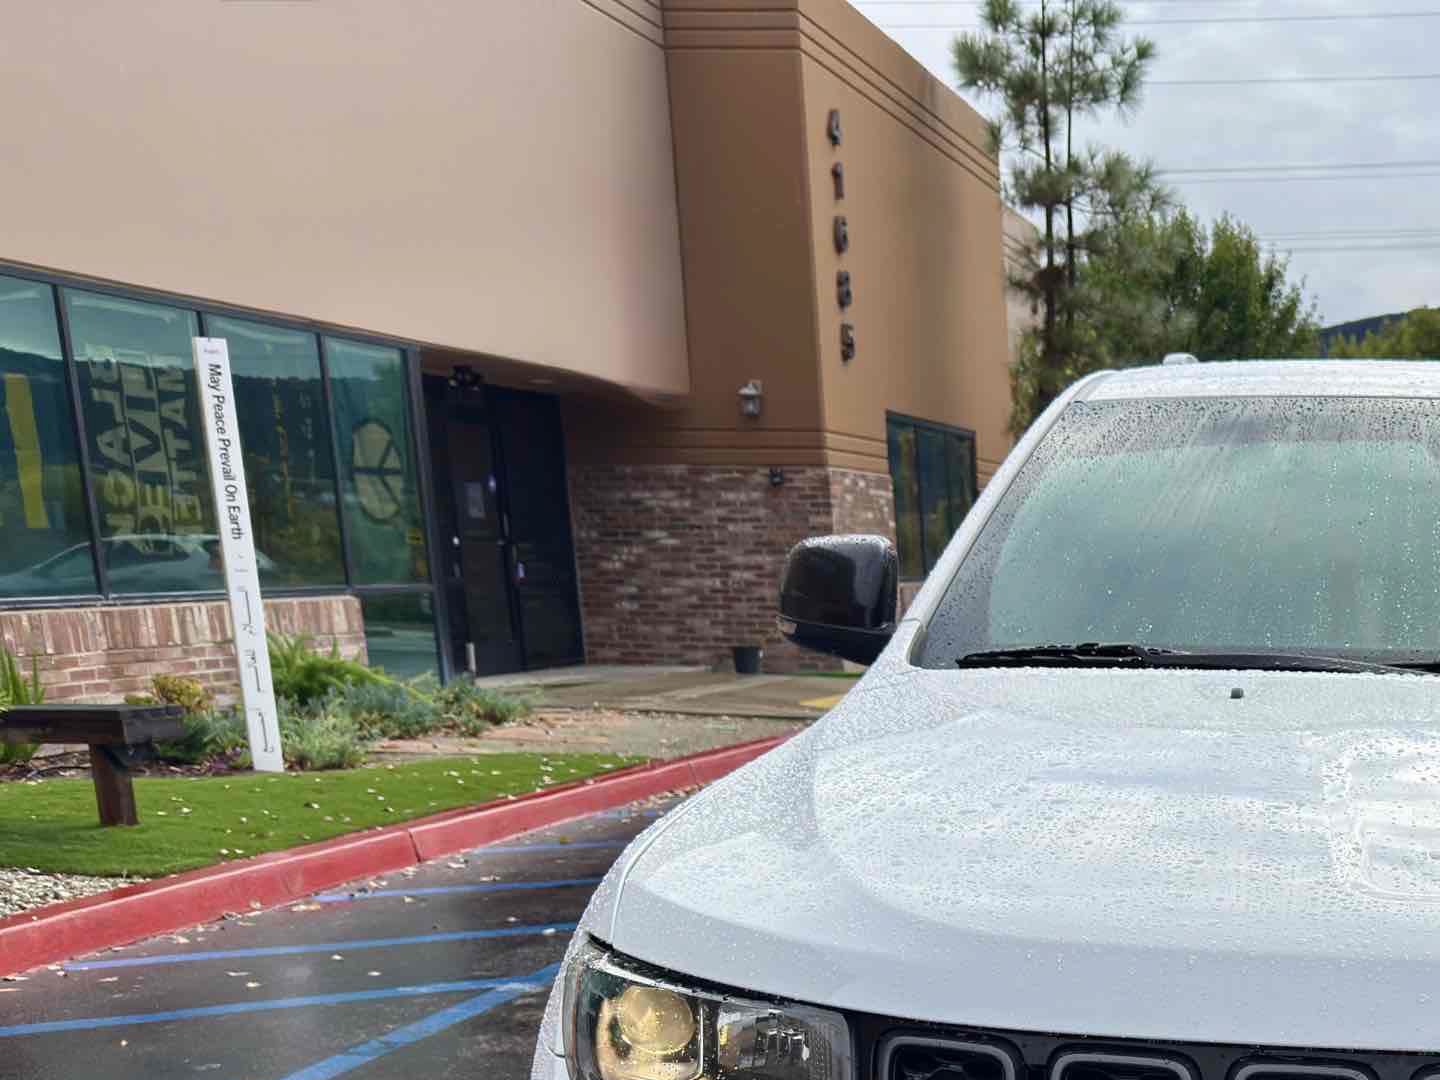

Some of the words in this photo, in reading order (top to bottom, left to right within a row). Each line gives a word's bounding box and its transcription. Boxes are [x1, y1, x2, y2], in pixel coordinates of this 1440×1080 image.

[208, 362, 222, 392] May
[212, 394, 226, 435] Peace
[217, 438, 236, 481] Prevail
[225, 484, 239, 502] On
[227, 505, 244, 540] Earth
